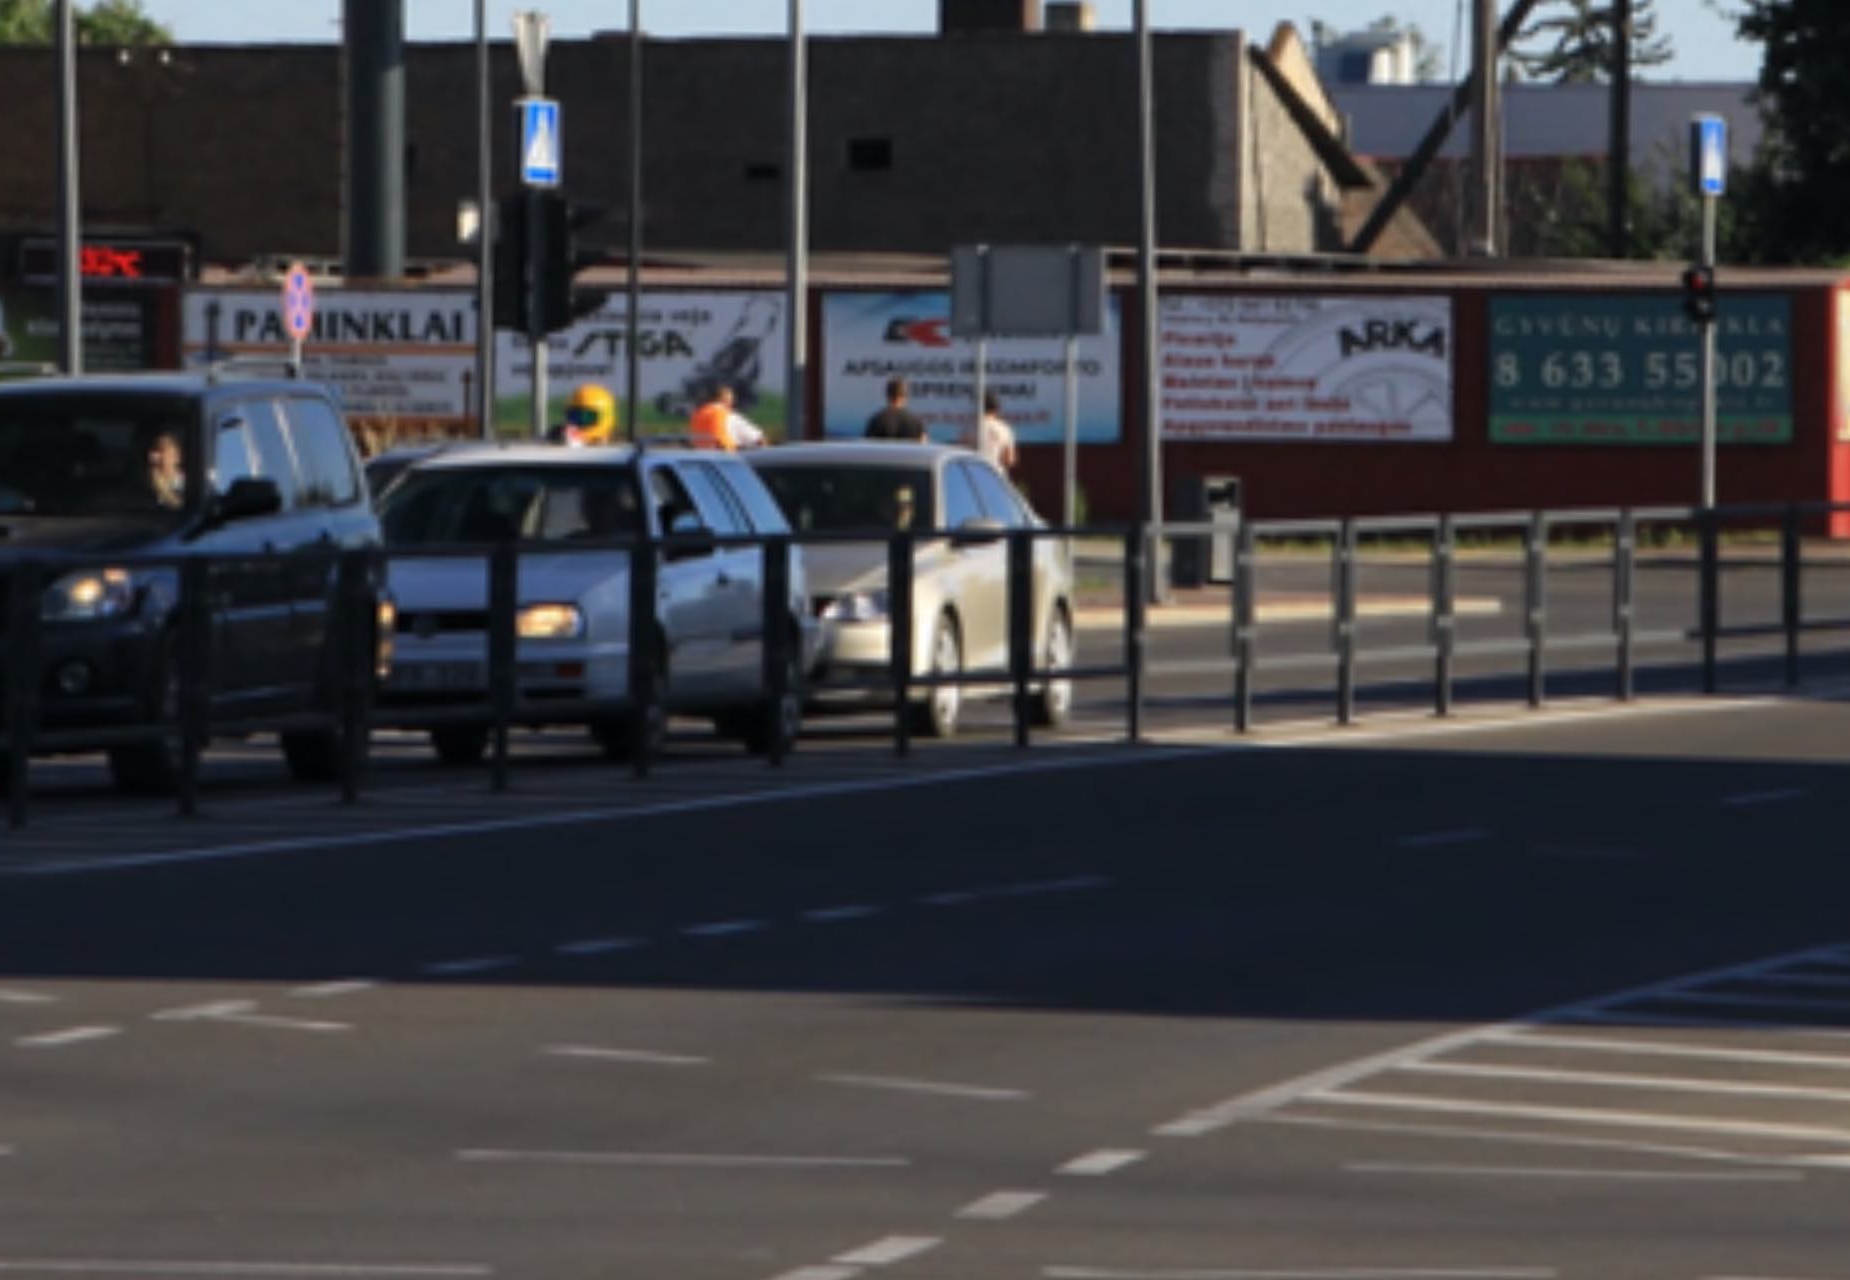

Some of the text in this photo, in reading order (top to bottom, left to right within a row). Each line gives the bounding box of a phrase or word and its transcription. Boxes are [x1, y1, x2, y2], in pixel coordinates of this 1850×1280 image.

[1338, 319, 1445, 361] ARKA
[1634, 314, 1785, 336] KIRKLA
[573, 328, 694, 358] STGA
[1495, 352, 1521, 388] 8
[1541, 351, 1624, 389] 633
